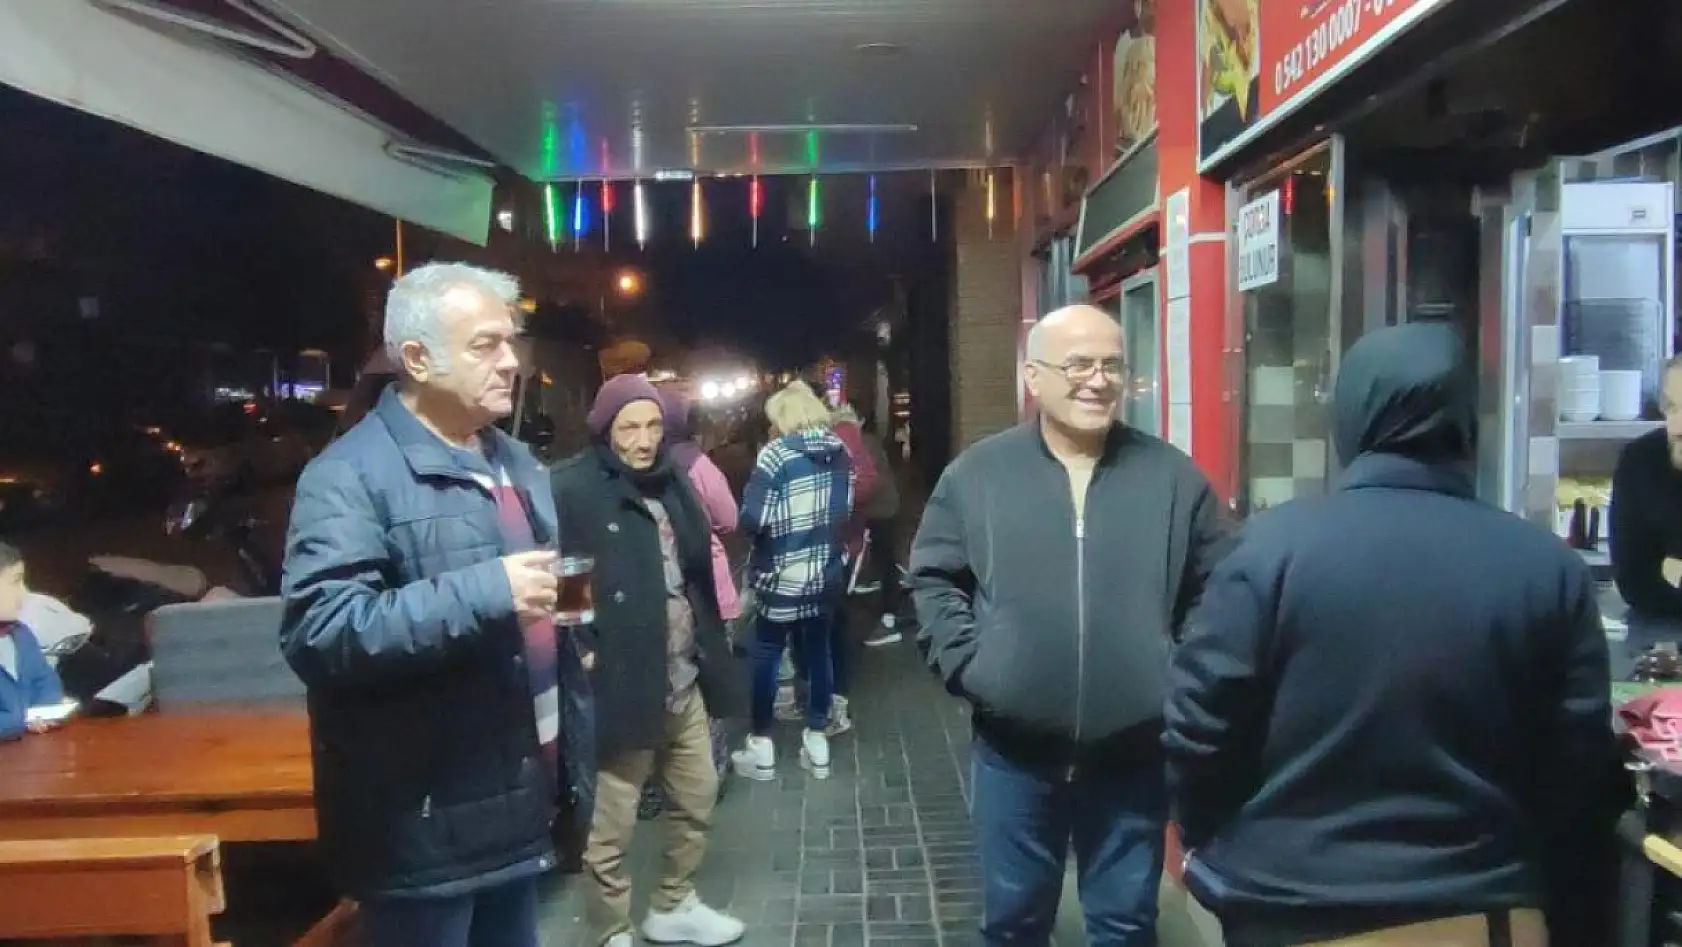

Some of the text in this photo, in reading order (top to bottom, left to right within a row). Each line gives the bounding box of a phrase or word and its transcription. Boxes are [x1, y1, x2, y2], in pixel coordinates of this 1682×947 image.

[1275, 61, 1283, 95] 0
[1283, 43, 1303, 89] 542
[1306, 22, 1327, 69] 130
